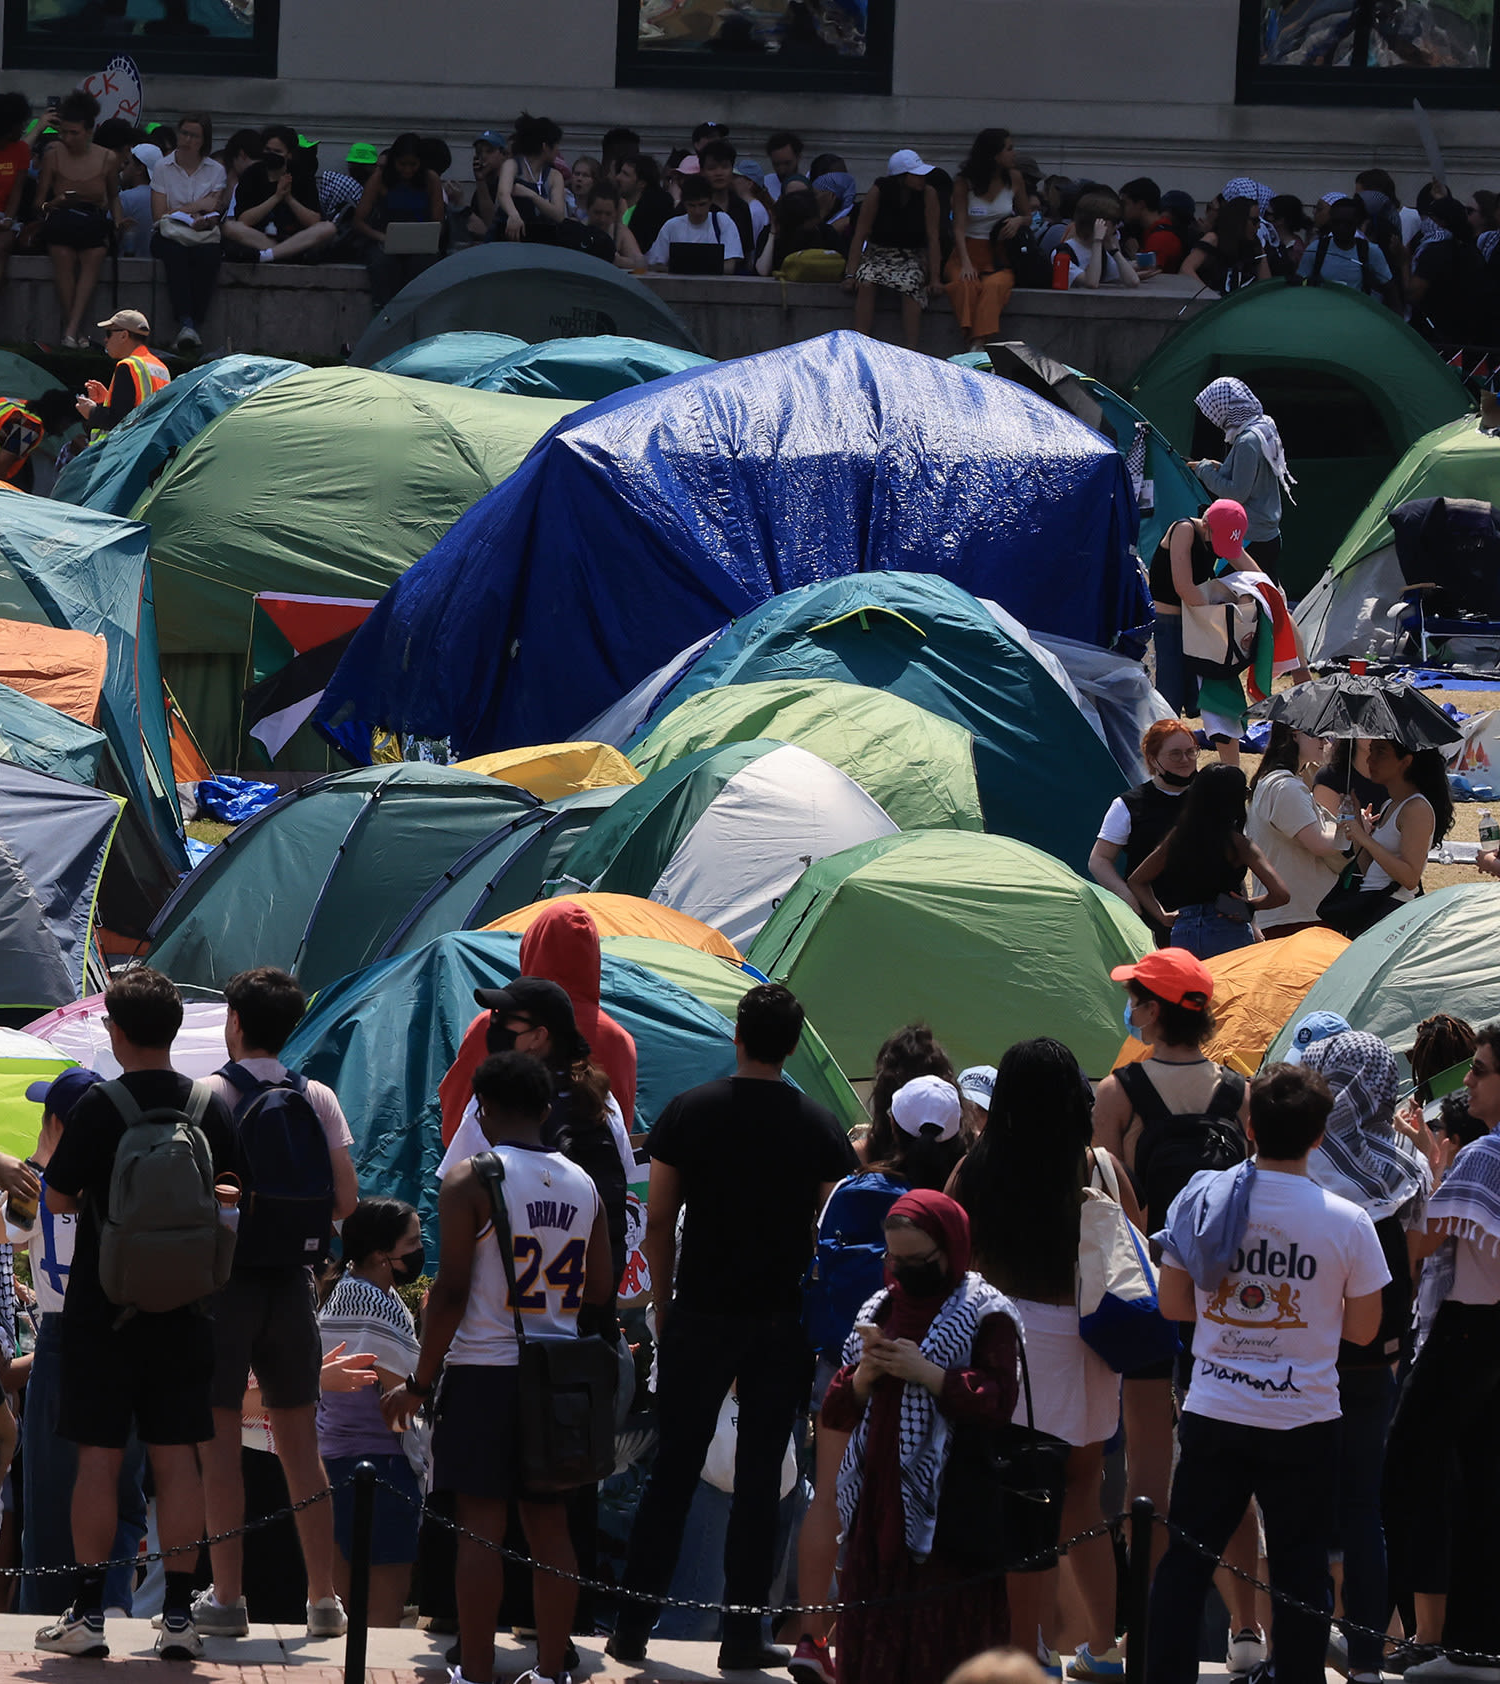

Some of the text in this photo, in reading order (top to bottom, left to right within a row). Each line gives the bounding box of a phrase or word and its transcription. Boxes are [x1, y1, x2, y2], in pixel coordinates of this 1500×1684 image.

[526, 1200, 578, 1232] BRYANT
[505, 1235, 586, 1314] 24
[1228, 1239, 1317, 1281] odelo
[1221, 1329, 1278, 1348] Especial
[1201, 1359, 1301, 1393] Diamond
